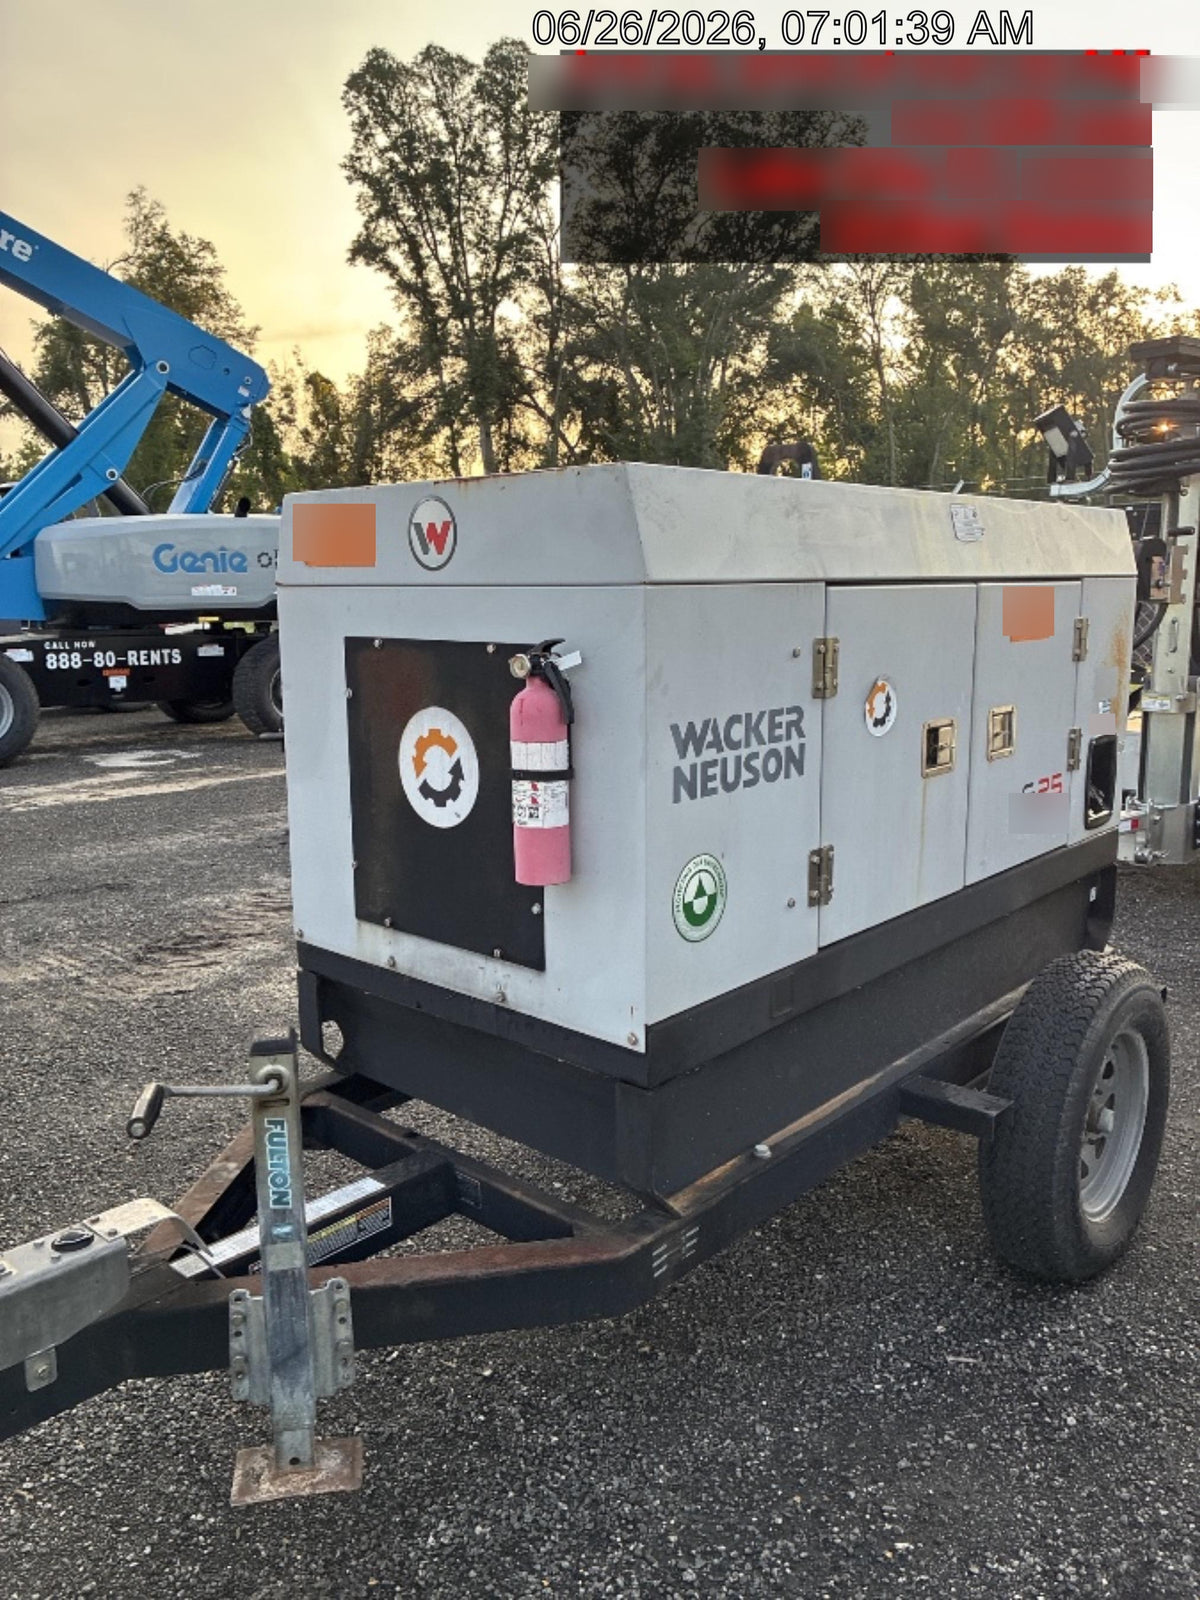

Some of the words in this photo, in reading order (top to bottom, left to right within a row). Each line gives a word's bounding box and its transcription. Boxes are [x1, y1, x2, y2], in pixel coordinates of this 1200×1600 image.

[153, 543, 248, 573] Genie
[44, 641, 71, 649] CALL
[46, 648, 182, 669] 888-80-RENTS
[670, 705, 805, 760] WACKER
[672, 743, 805, 804] NEUSON
[264, 1118, 293, 1209] FULTON
